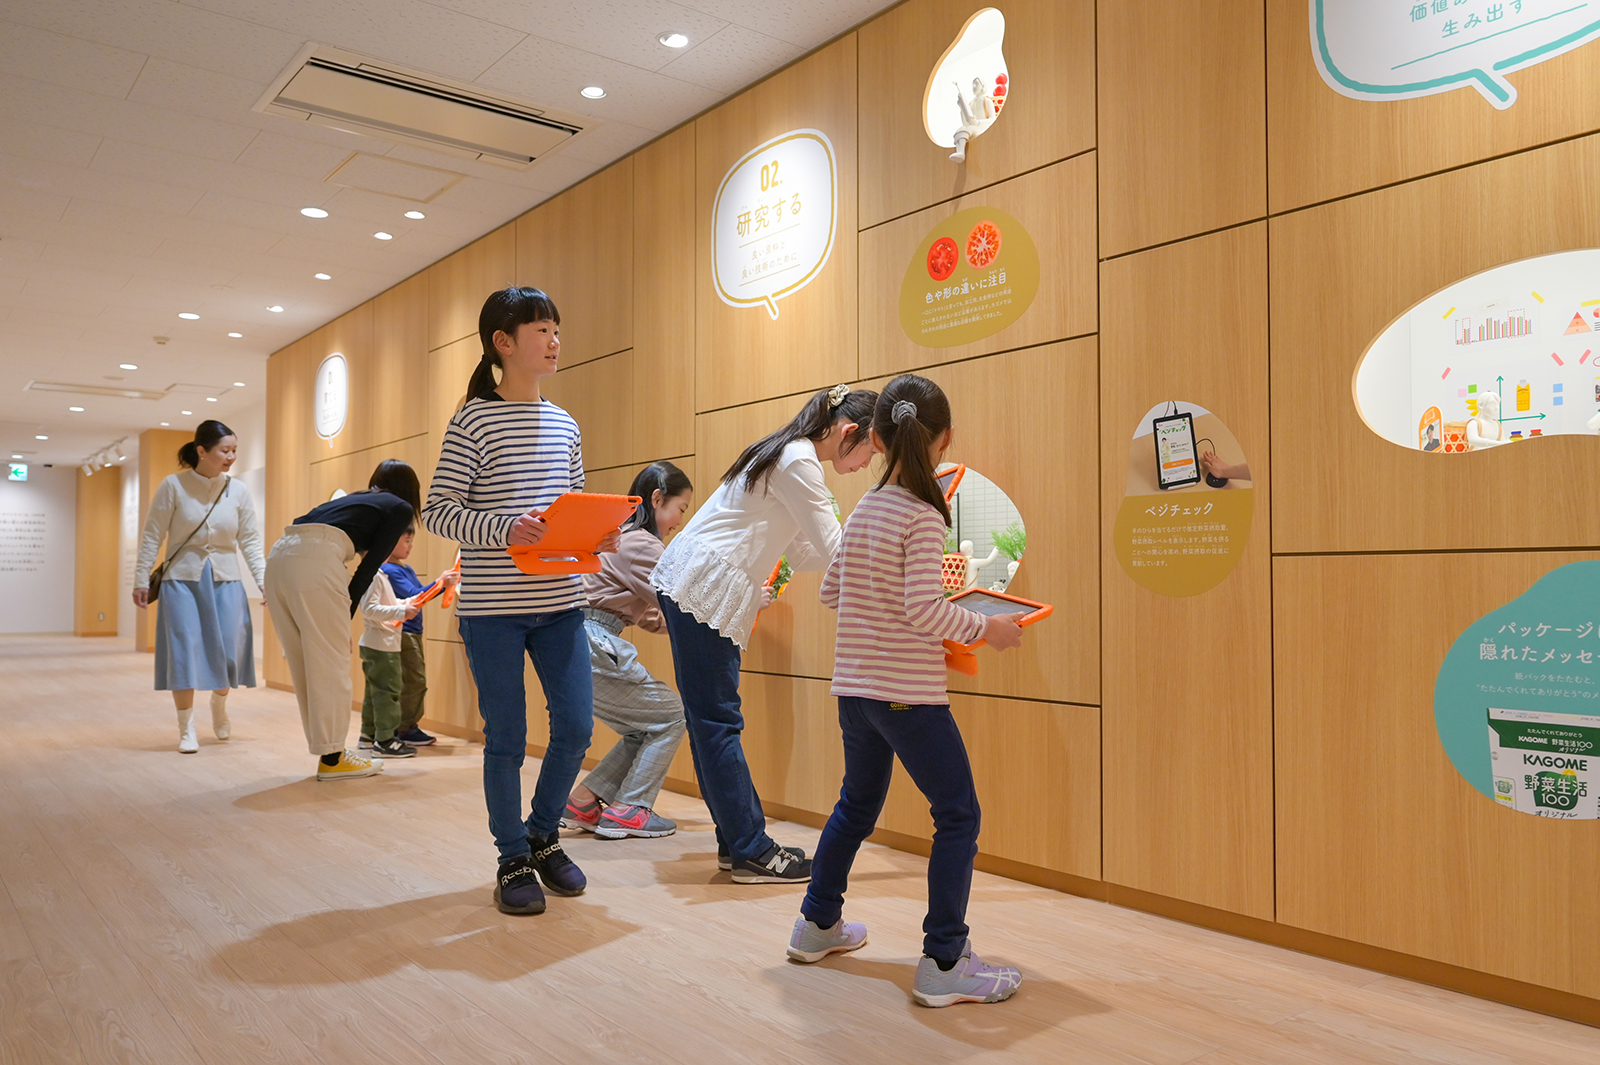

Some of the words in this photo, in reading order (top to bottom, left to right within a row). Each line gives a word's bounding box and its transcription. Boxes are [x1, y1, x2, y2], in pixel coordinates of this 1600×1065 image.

[1442, 0, 1522, 38] 生み出す
[737, 193, 801, 237] 研究する
[925, 272, 1007, 304] 色や形の違いに注目
[1145, 502, 1214, 517] ベジチェック
[1498, 621, 1600, 640] パッケージ
[1480, 643, 1600, 664] 隠れたメッセ
[1515, 672, 1595, 686] 紙パックをたたむと、
[1518, 736, 1548, 745] KAGOME
[1527, 728, 1583, 738] たたんでくれてありがとう
[1523, 754, 1588, 772] KAGOME
[1524, 774, 1588, 798] 野菜生活
[1541, 793, 1570, 807] 100
